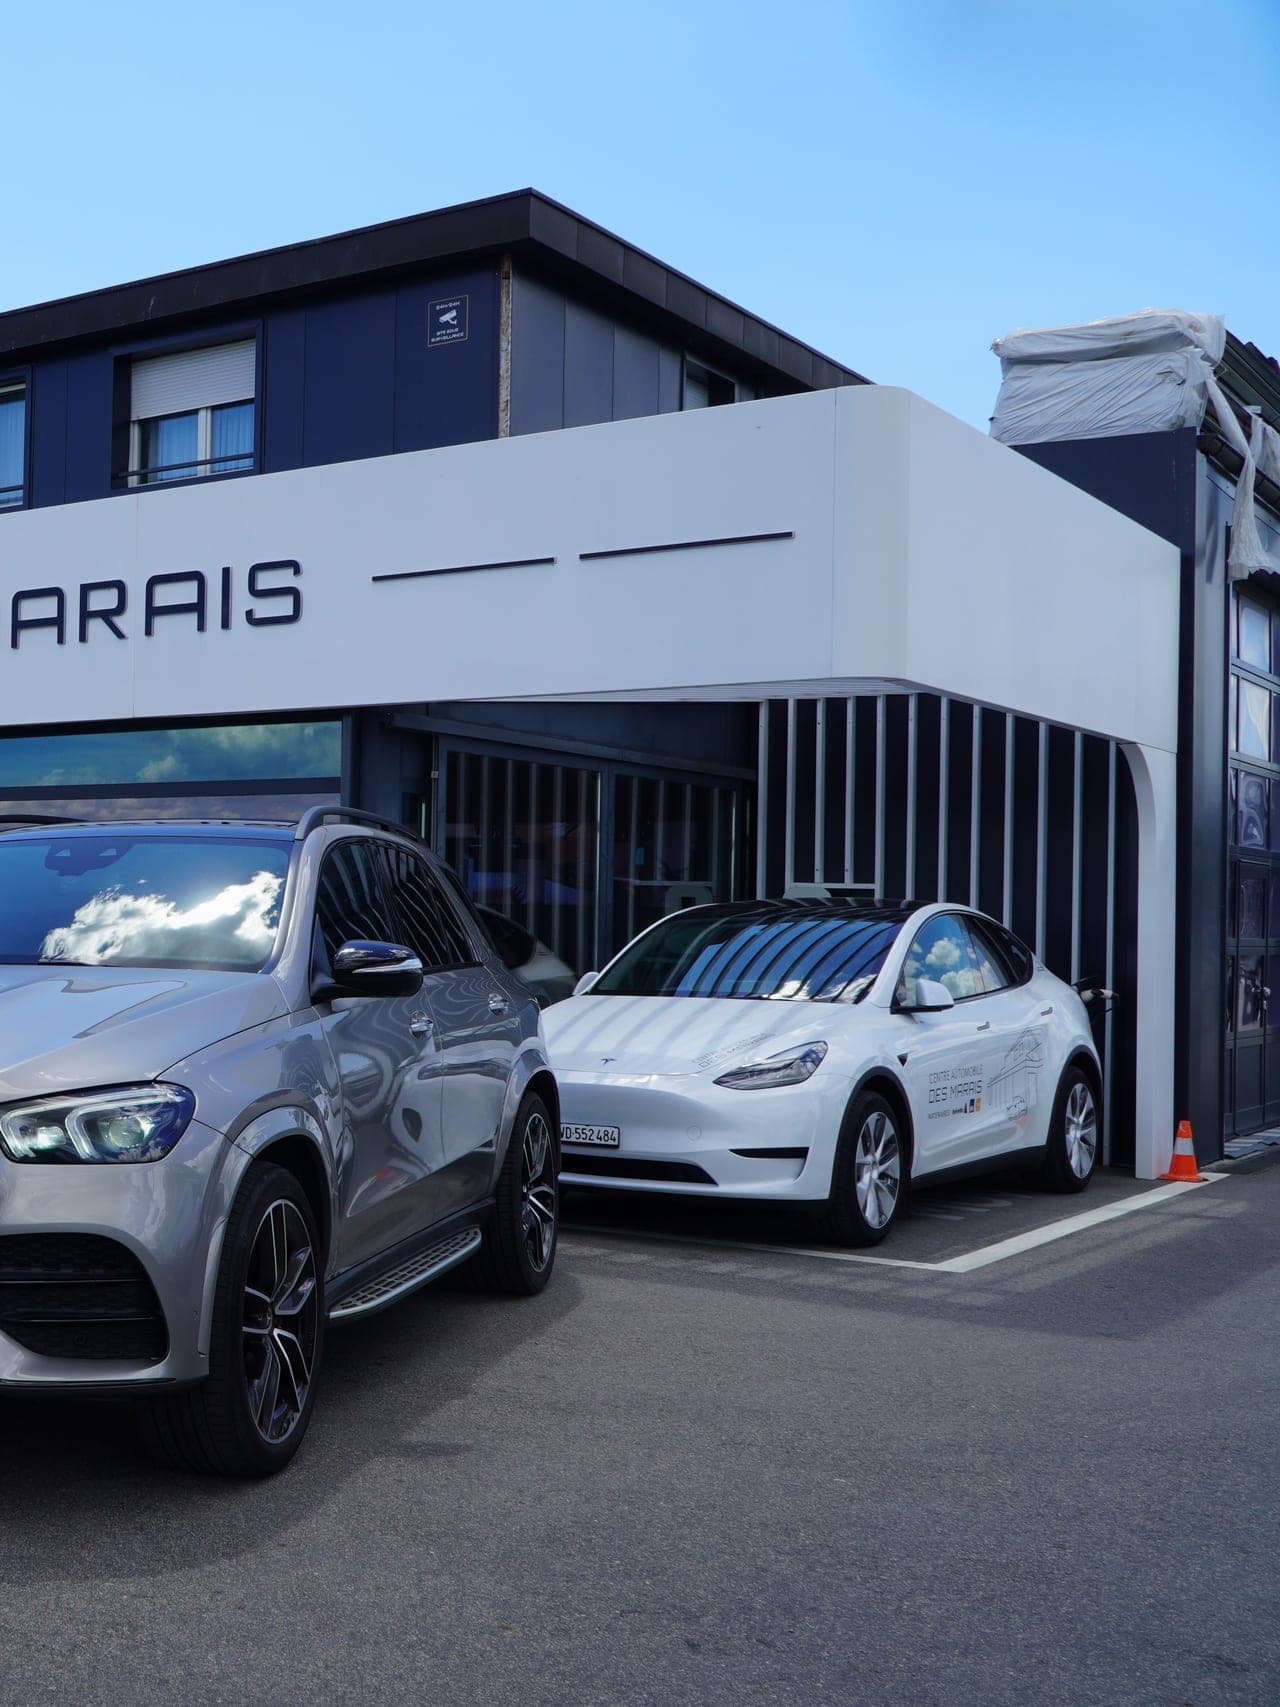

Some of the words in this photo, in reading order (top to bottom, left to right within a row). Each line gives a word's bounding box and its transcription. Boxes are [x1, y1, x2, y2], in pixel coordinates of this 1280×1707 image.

[928, 1086, 948, 1103] DES
[949, 1080, 983, 1099] MARAIS
[596, 1129, 616, 1142] 484
